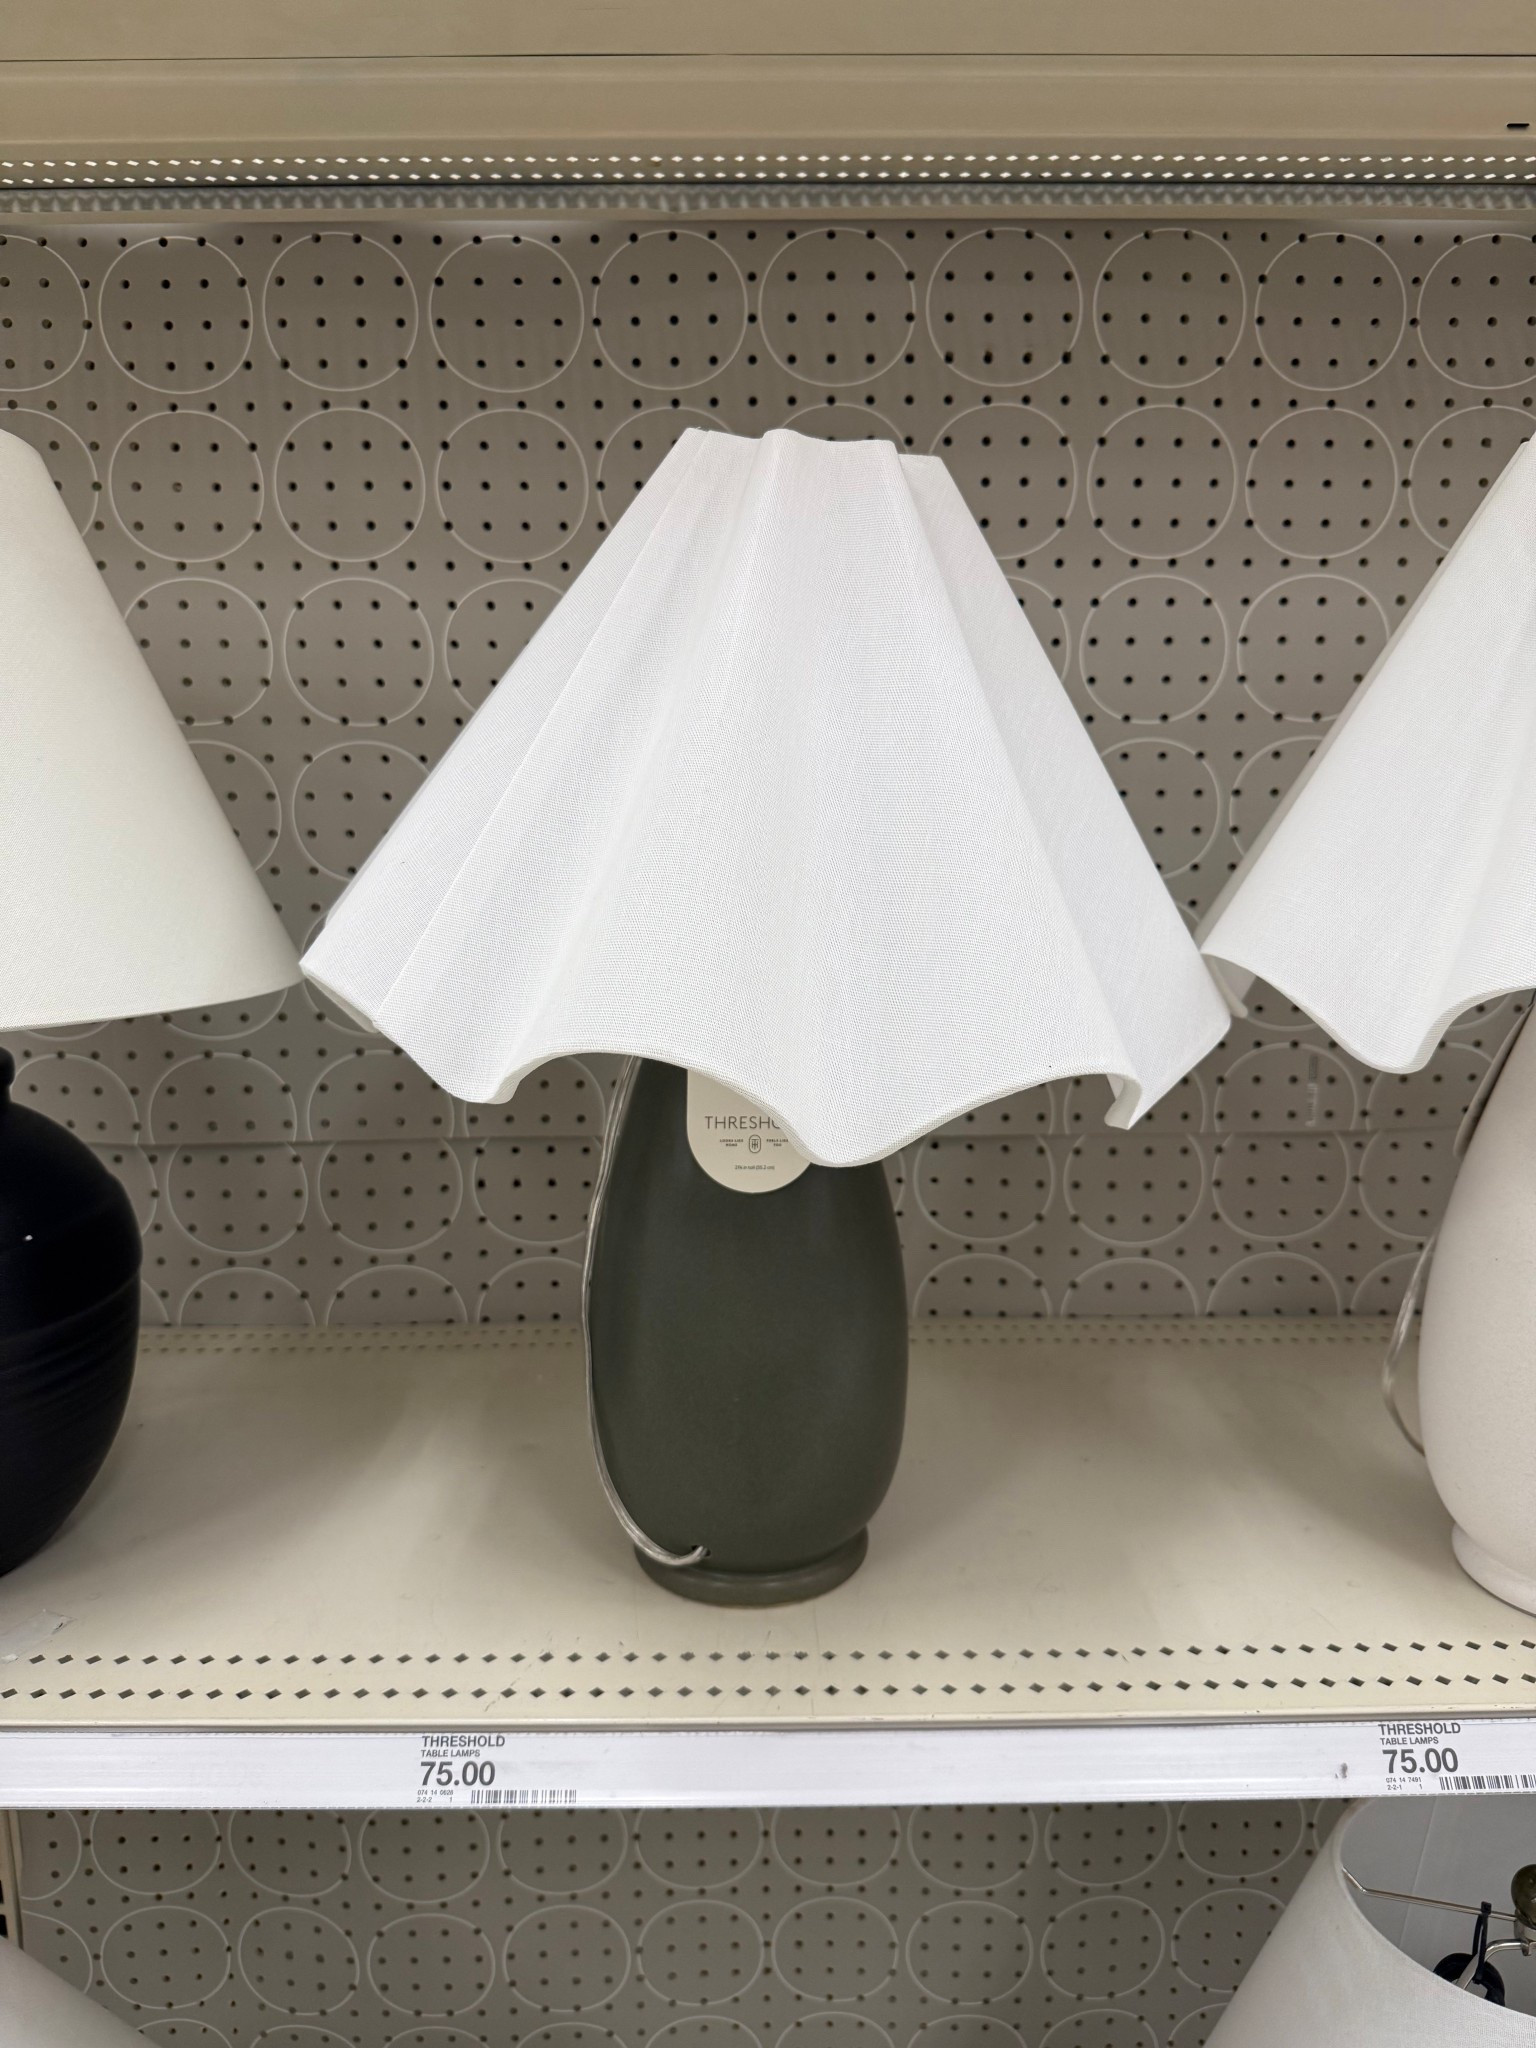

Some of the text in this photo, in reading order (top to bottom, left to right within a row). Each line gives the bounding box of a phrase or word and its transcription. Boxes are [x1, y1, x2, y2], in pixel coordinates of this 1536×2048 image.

[704, 1115, 781, 1130] THRESH
[1378, 1722, 1461, 1736] THRESHOLD
[421, 1735, 506, 1748] THRESHOLD
[1380, 1736, 1439, 1746] TABLE LAMPS
[421, 1749, 481, 1758] TABLE LAMPS
[1382, 1747, 1459, 1774] 75.00
[420, 1760, 496, 1787] 75.00
